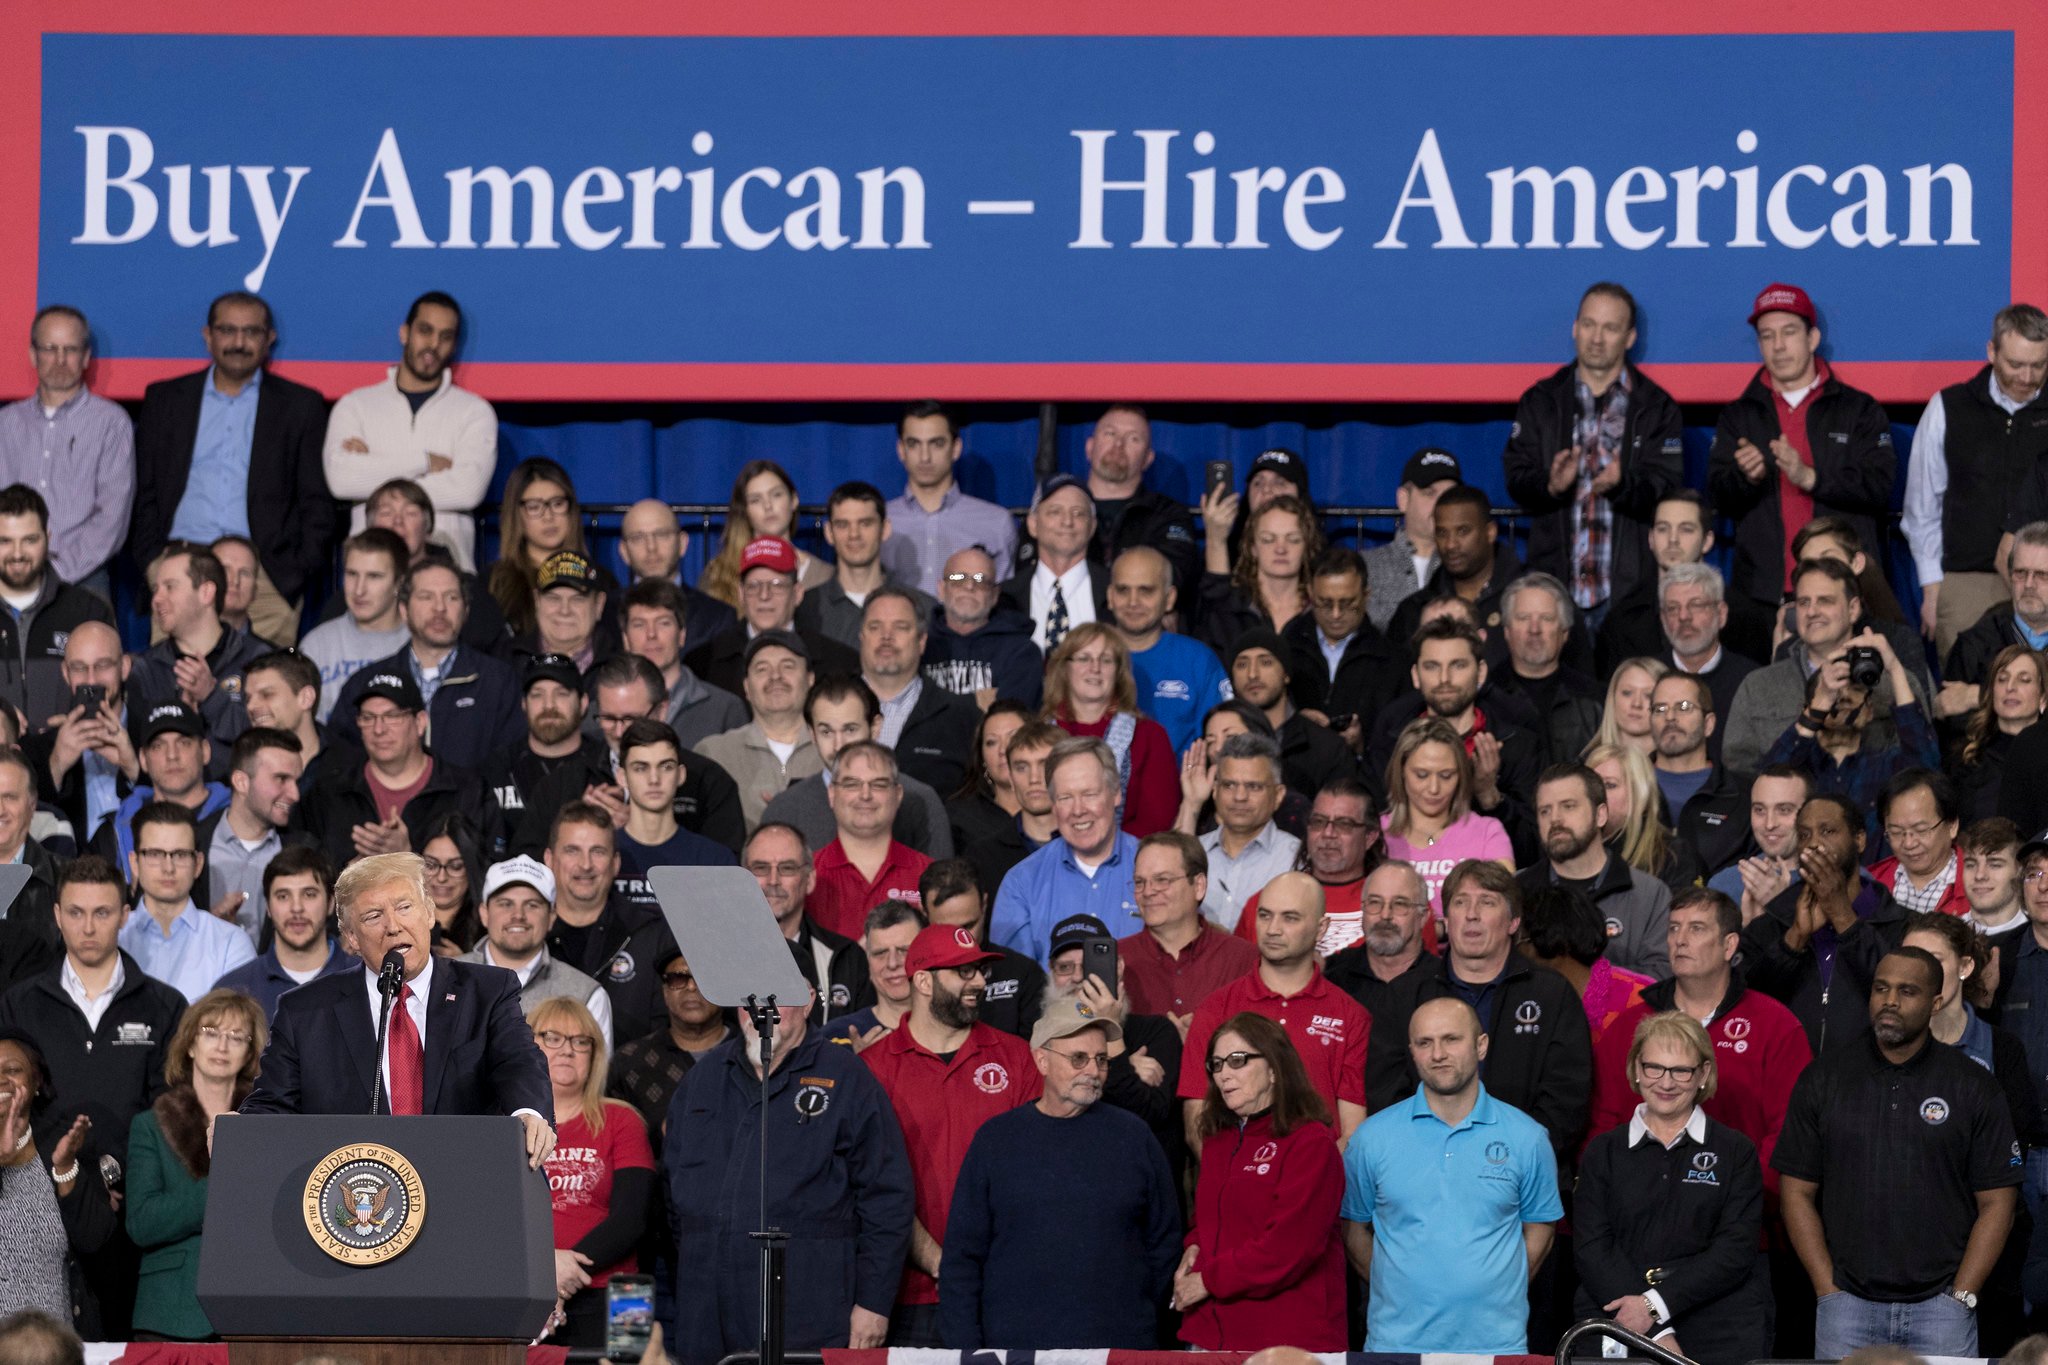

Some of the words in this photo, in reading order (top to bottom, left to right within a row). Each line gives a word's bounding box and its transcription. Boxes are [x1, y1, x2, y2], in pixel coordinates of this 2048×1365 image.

[72, 125, 311, 293] Buy
[333, 127, 932, 252] American
[1068, 128, 1347, 252] Hire
[1373, 127, 1982, 252] American
[367, 1149, 378, 1158] OF
[380, 1151, 396, 1165] THE
[308, 1147, 364, 1200] PRESIDENT
[546, 1170, 583, 1191] om
[1687, 1169, 1716, 1182] FCA
[397, 1162, 422, 1214] UNITED
[309, 1203, 317, 1220] THE
[313, 1222, 322, 1233] OF
[320, 1232, 352, 1259] SEAL
[372, 1222, 416, 1259] STATES
